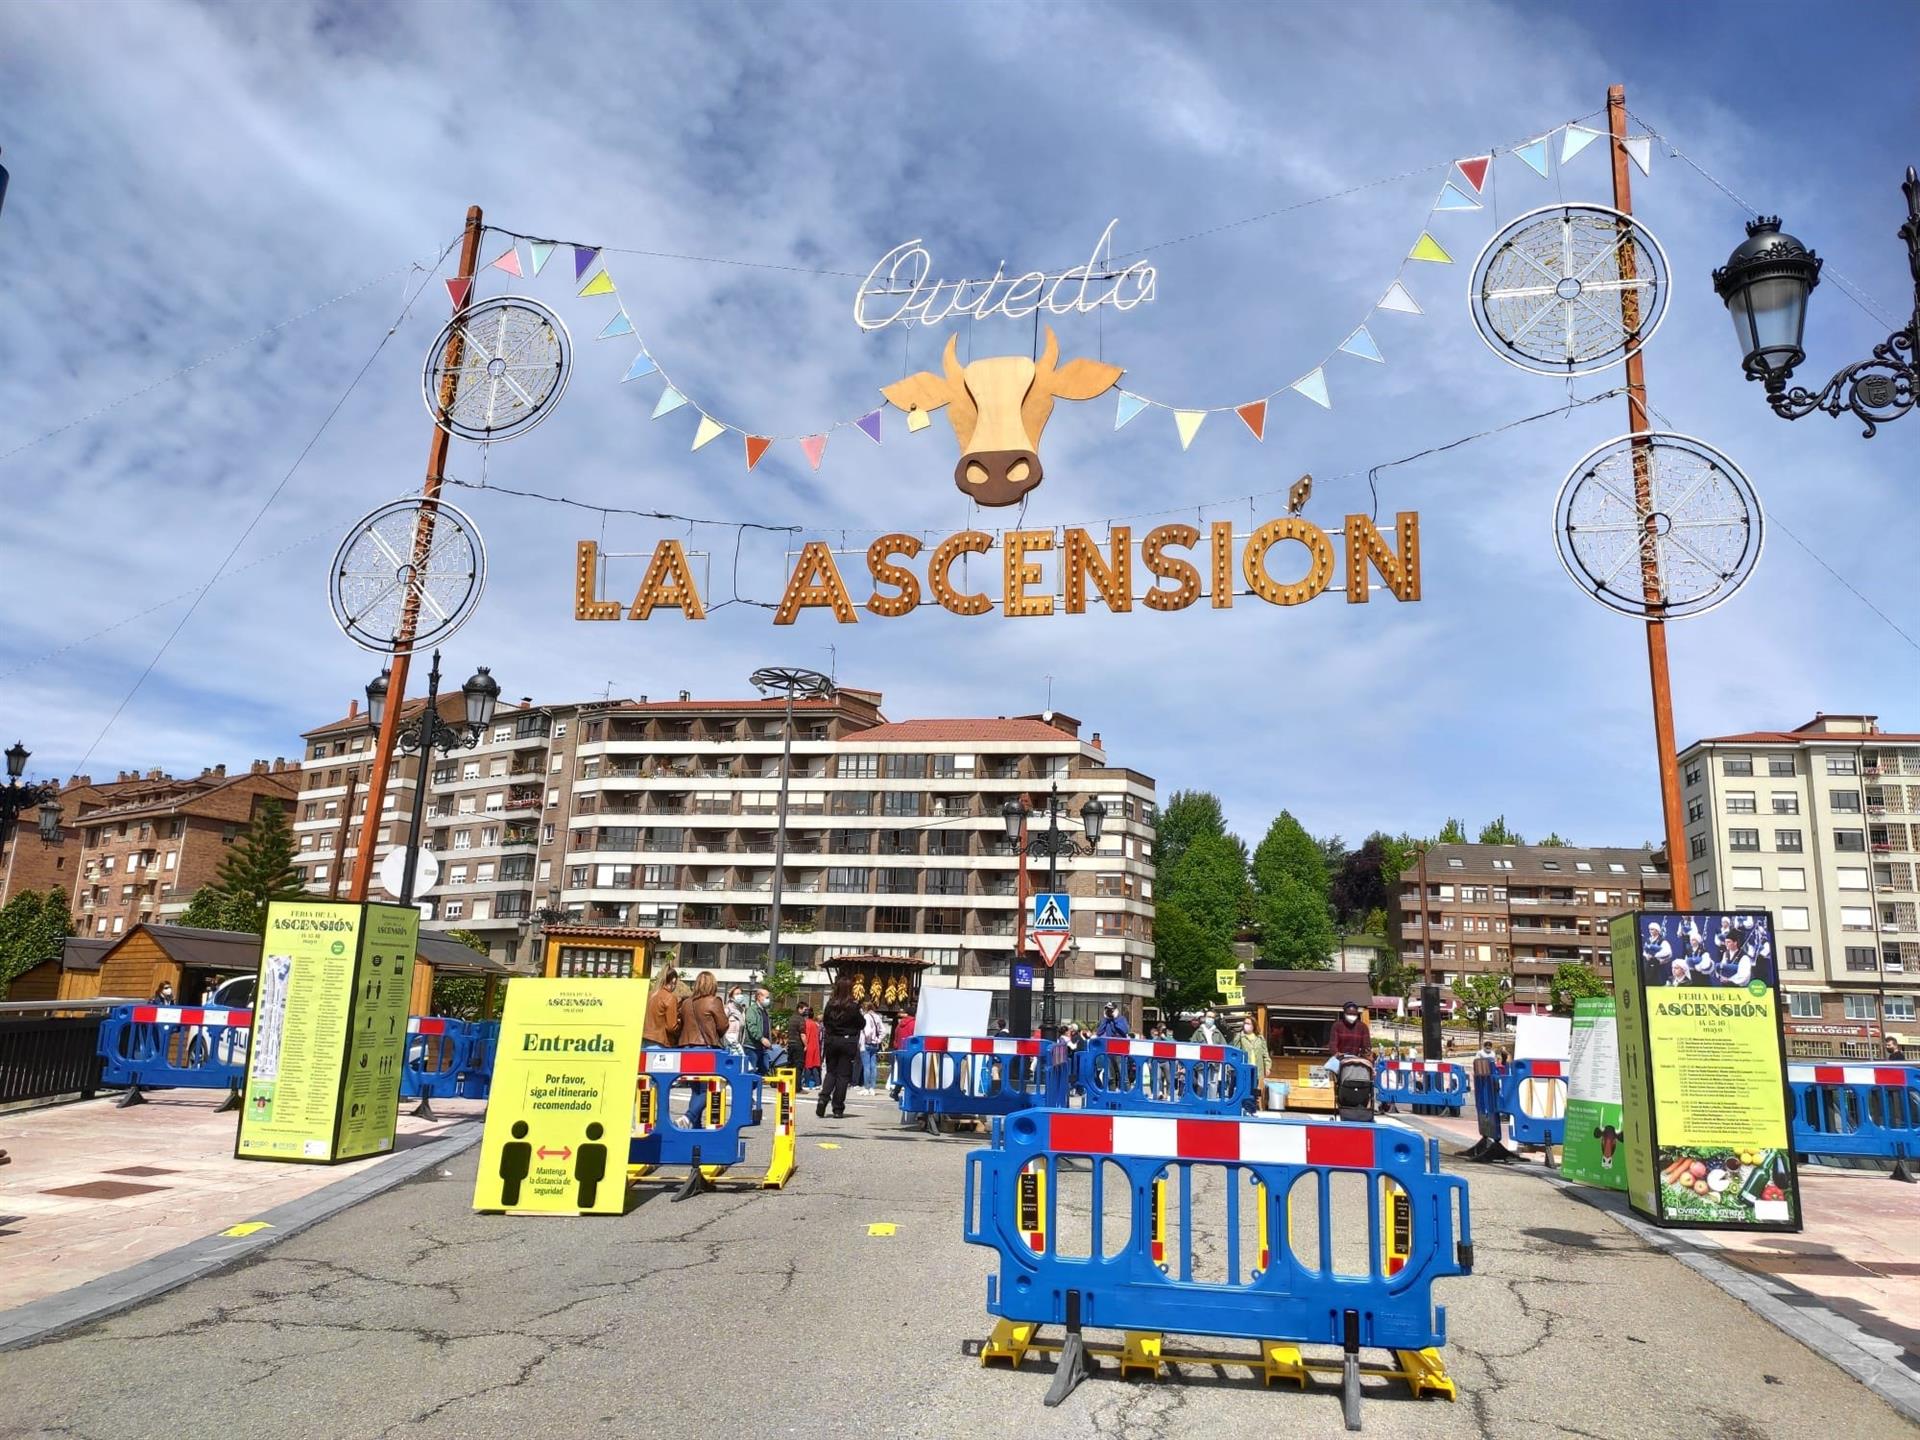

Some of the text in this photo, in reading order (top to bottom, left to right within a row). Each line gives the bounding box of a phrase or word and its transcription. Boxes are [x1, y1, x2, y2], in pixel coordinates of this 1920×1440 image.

[854, 218, 1156, 329] Oviedo
[575, 473, 1421, 625] LA ASCENSIÓN
[290, 910, 313, 918] FERIA
[272, 918, 353, 932] ASCENSIÓN
[1711, 993, 1726, 1001] DE
[1728, 993, 1742, 1001] LA
[1655, 1001, 1767, 1017] ASCENSIÓN
[522, 1033, 614, 1052] Entrada
[545, 1074, 586, 1085] Por favor,
[530, 1086, 598, 1099] siga el itinerario
[533, 1100, 592, 1110] recomendado
[536, 1167, 566, 1176] Mantenga
[535, 1177, 562, 1185] distancia
[534, 1187, 564, 1196] seguridad
